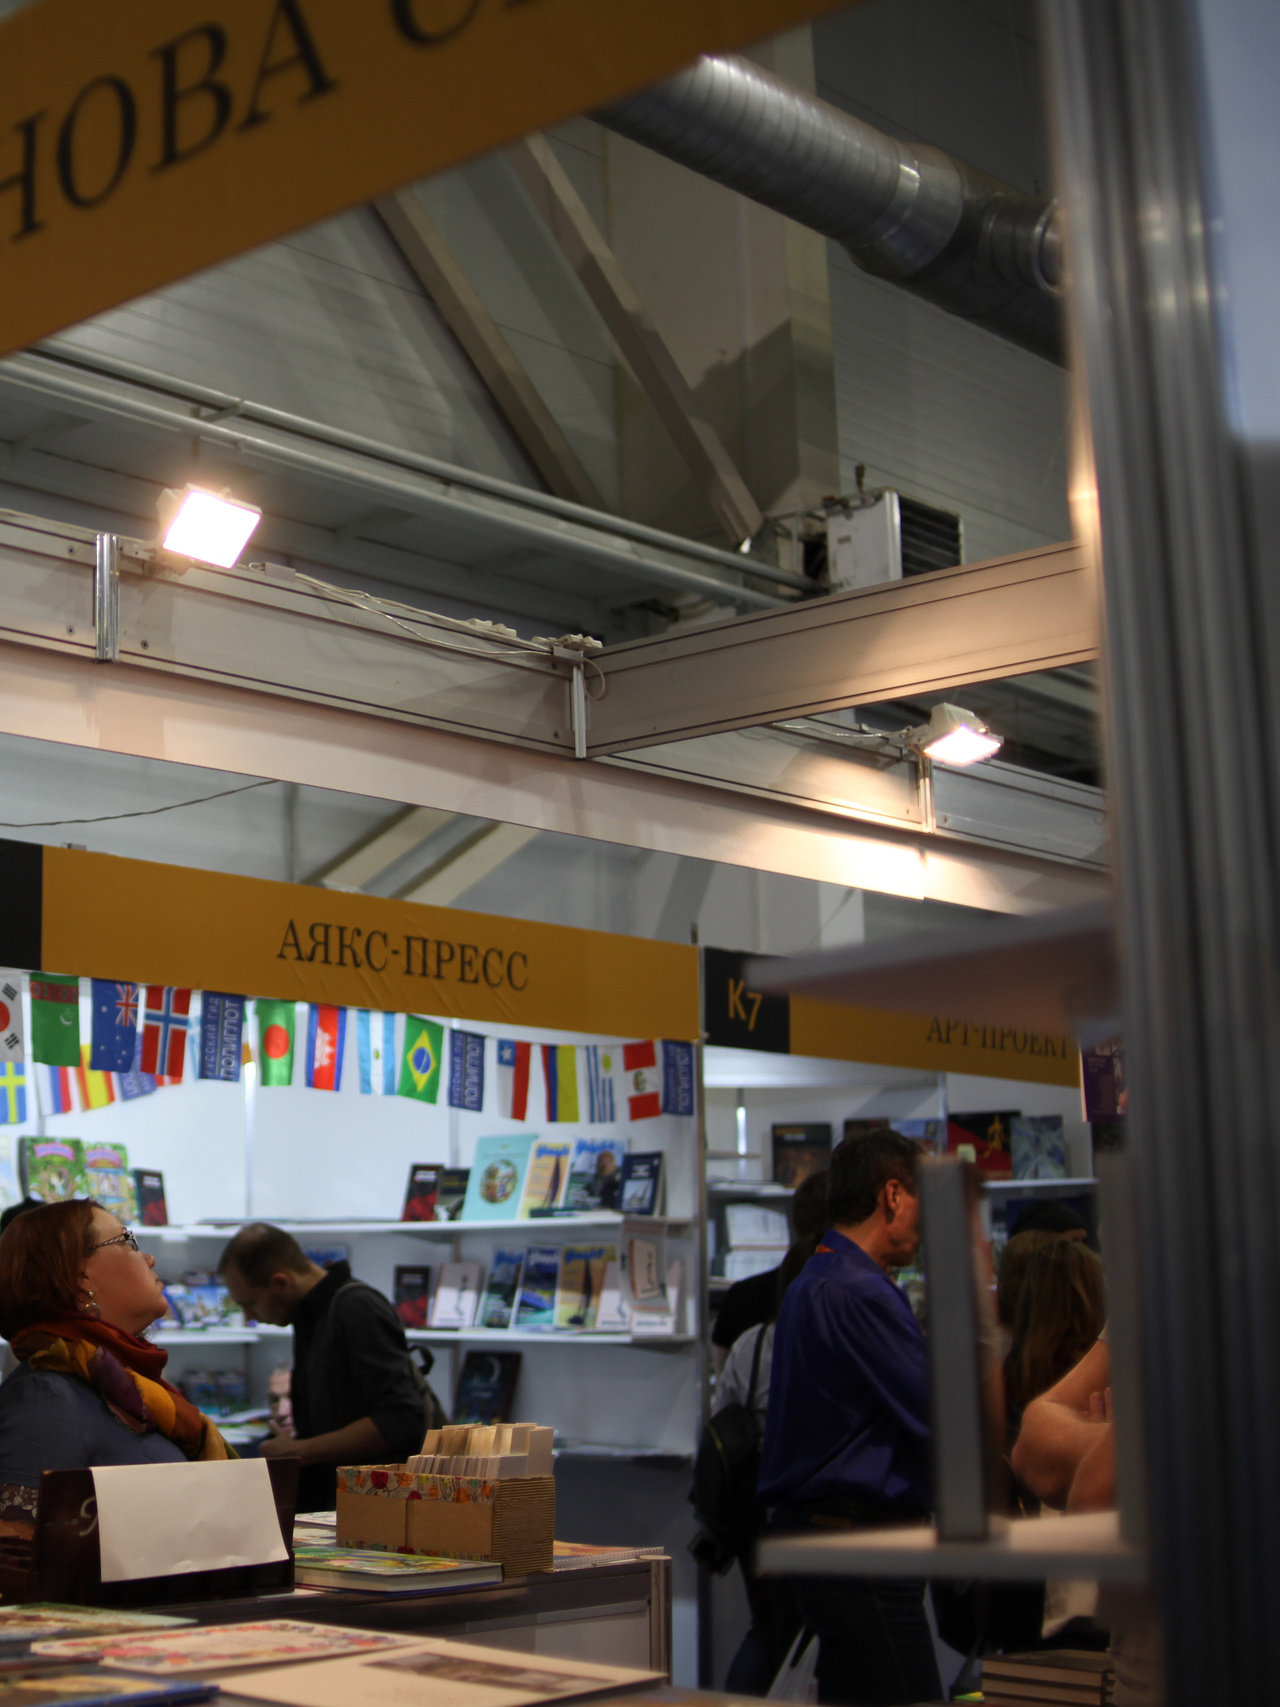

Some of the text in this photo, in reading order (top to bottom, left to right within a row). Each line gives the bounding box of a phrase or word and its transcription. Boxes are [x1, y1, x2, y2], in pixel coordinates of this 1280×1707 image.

[276, 918, 529, 991] АЯКС-ПРЕСС
[204, 997, 219, 1077] РУССКИЙ ГИД
[220, 999, 240, 1080] ПОЛИГЛОТ
